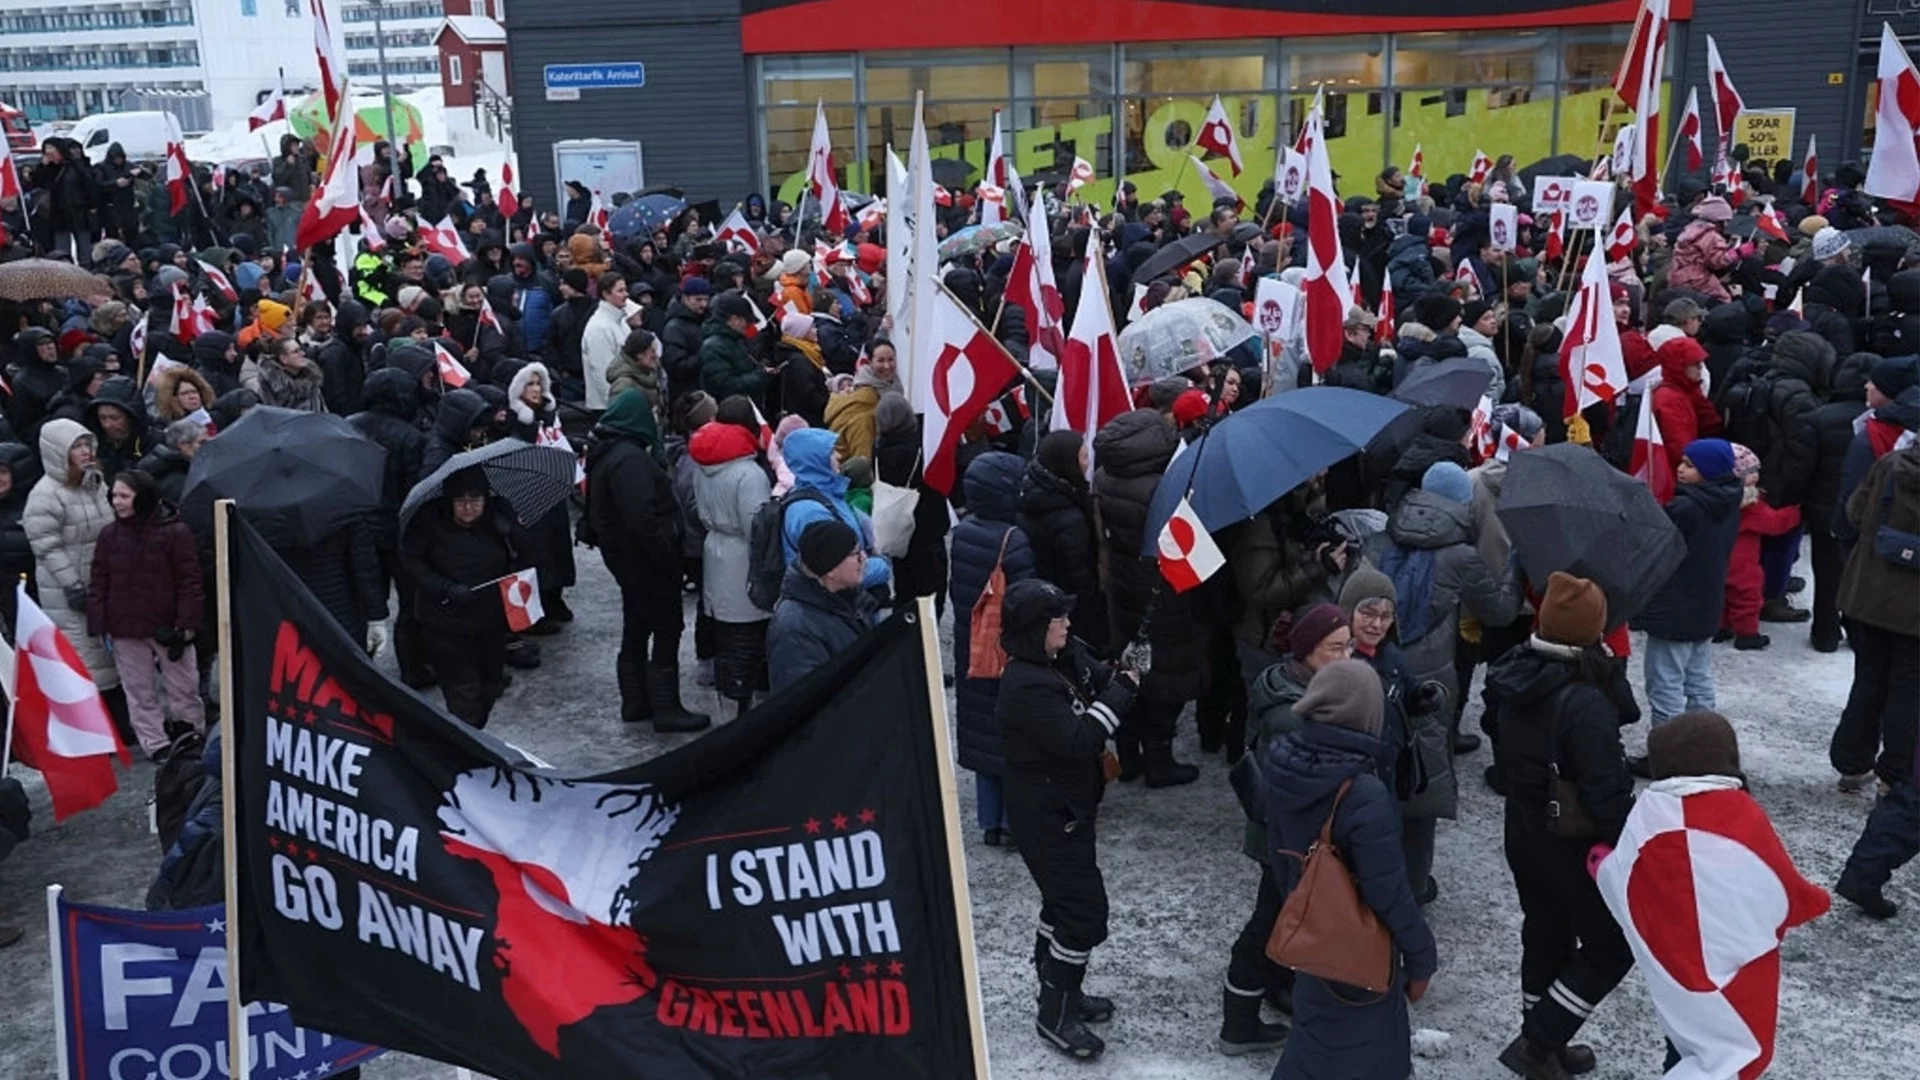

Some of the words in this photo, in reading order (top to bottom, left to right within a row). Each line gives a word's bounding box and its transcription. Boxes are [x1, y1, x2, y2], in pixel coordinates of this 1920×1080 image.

[1747, 118, 1780, 130] SPAR
[1749, 131, 1777, 143] 50%
[1750, 144, 1779, 156] LLER
[266, 716, 372, 798] MAKE
[266, 779, 420, 883] AMERICA
[705, 853, 723, 911] I
[730, 829, 887, 907] STAND
[271, 853, 344, 931] GO
[357, 880, 485, 992] AWAY
[772, 899, 902, 967] WITH
[655, 978, 912, 1039] GREENLAND
